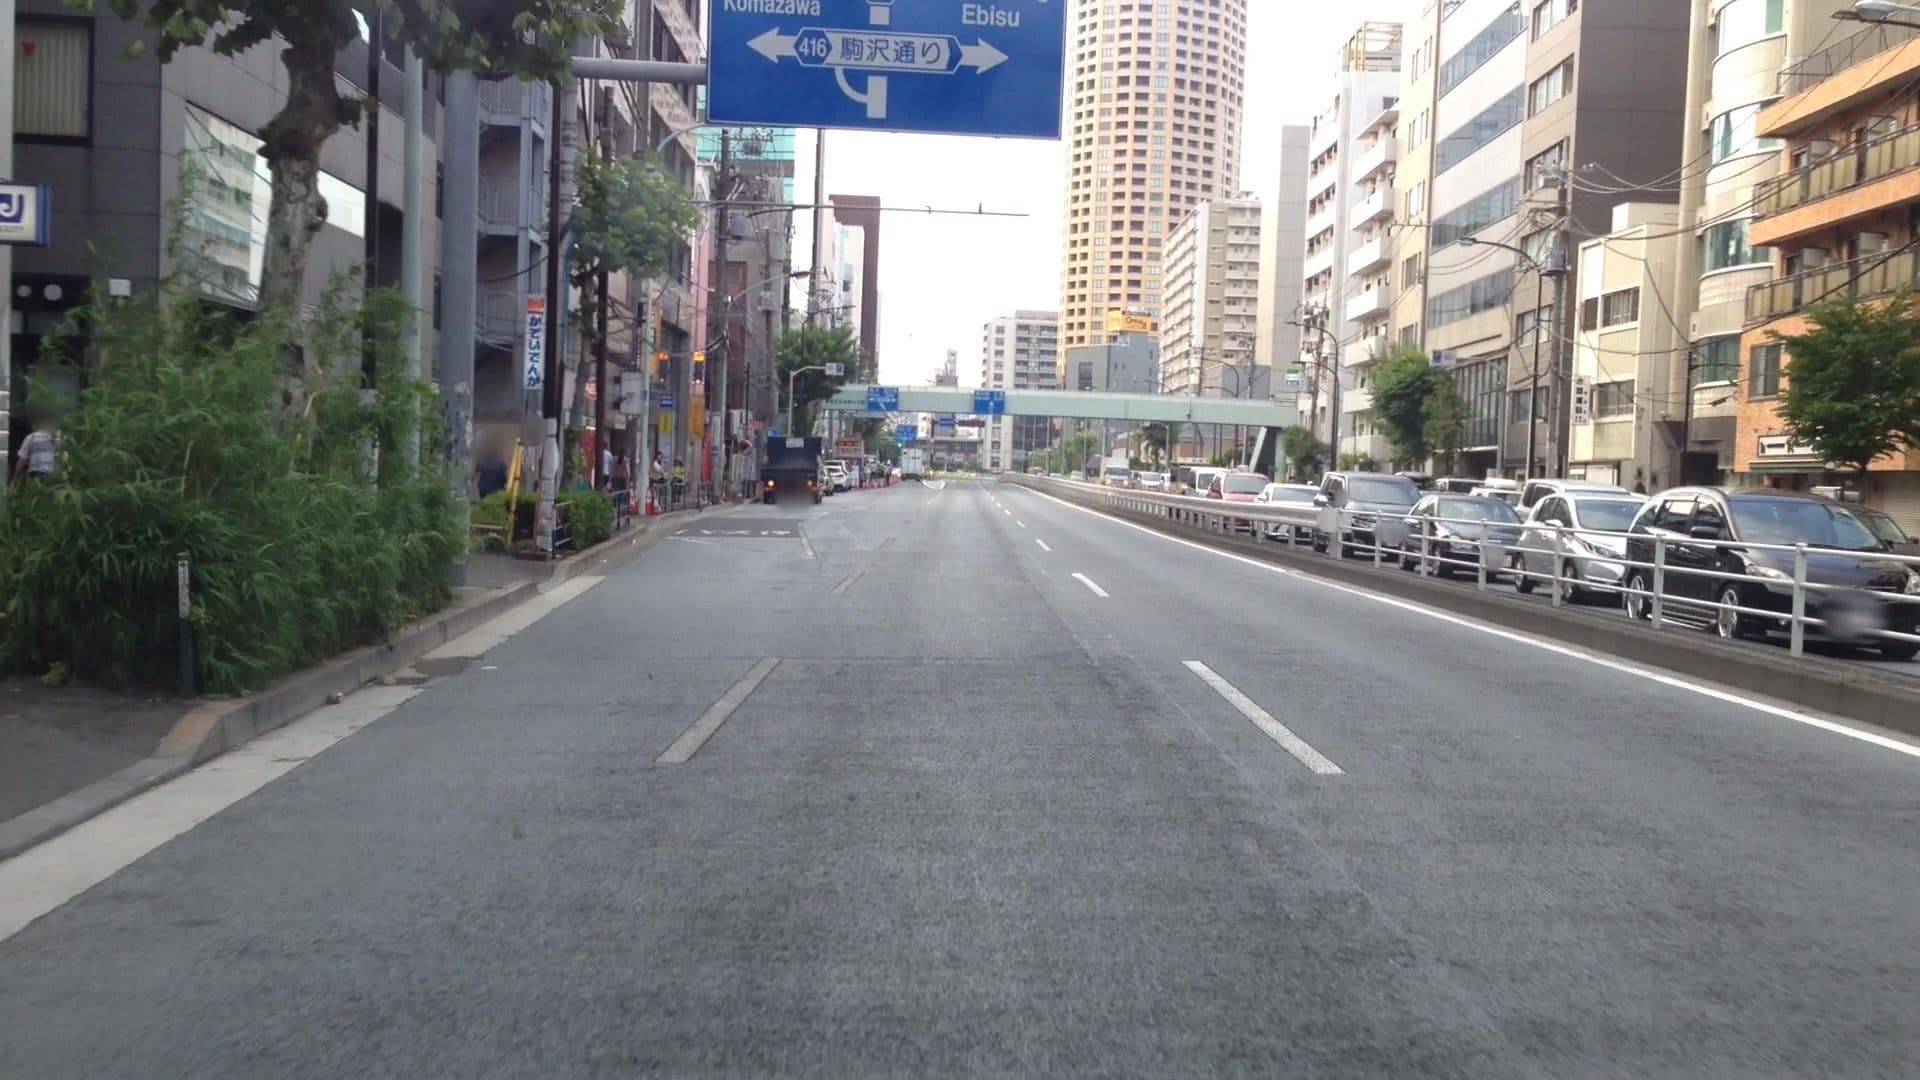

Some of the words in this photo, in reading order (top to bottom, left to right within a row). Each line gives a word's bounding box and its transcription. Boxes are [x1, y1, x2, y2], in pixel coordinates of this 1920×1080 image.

[962, 4, 1020, 27] Ebisu
[798, 37, 827, 58] 416
[840, 37, 942, 65] 駒沢通り
